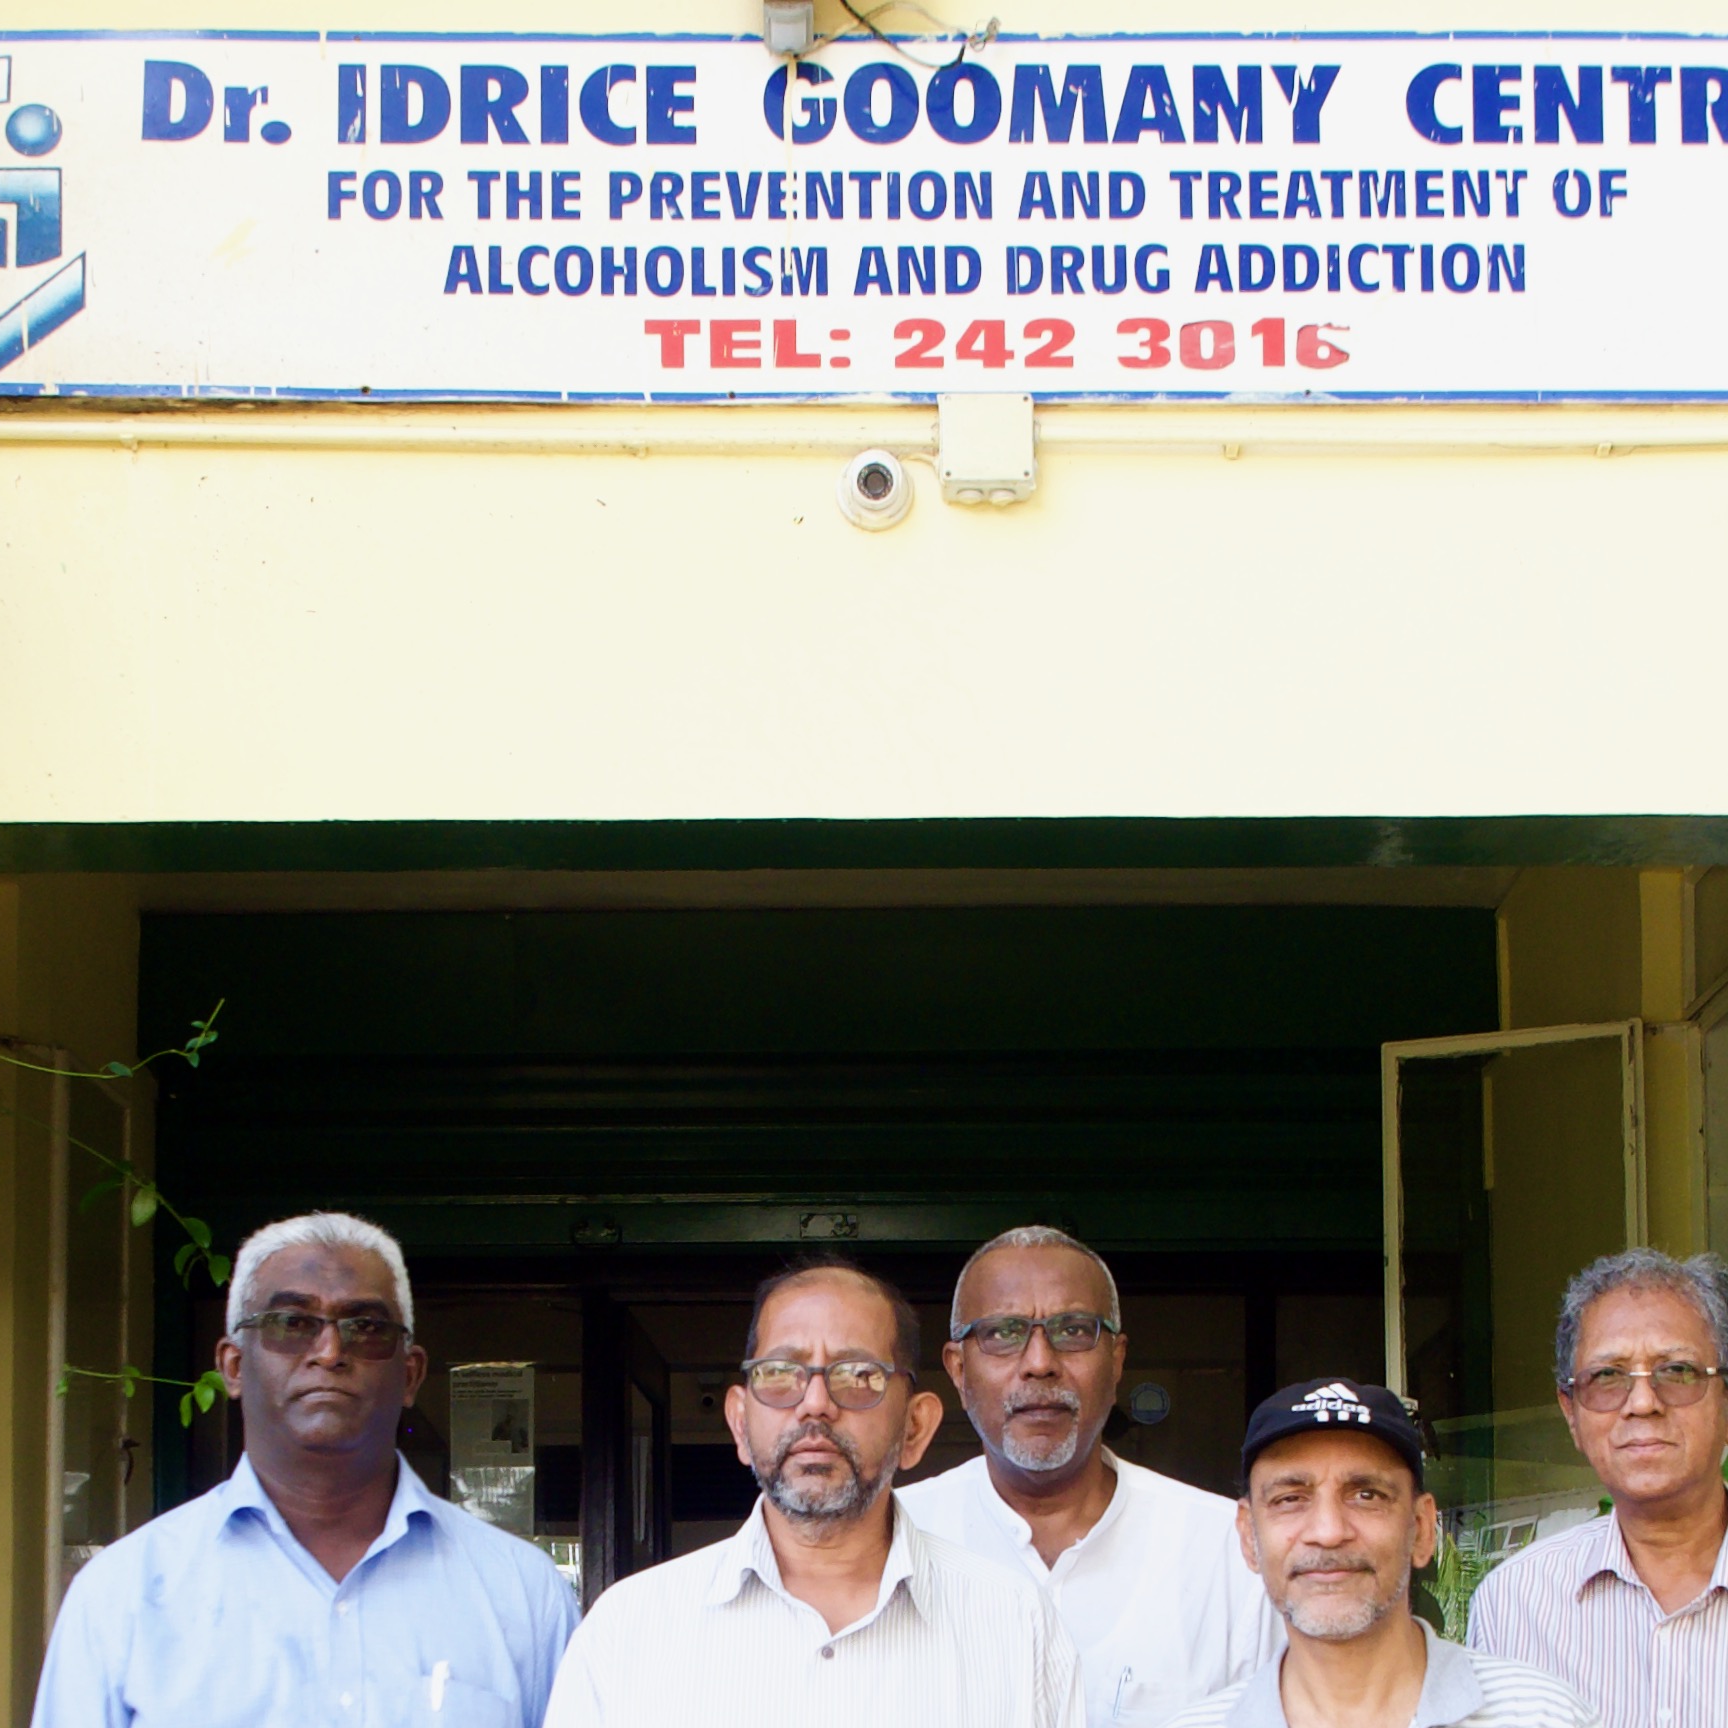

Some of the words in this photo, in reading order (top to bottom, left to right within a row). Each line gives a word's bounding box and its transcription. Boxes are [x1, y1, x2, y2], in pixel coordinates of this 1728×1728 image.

[143, 60, 292, 144] Dr.
[337, 63, 697, 145] IDRICE
[763, 60, 1341, 145] GOOMANY
[327, 169, 443, 220] FOR
[468, 169, 582, 220] THE
[609, 169, 993, 221] PREVENTION
[1018, 170, 1147, 220] AND
[1169, 169, 1529, 219] TREATMENT
[1552, 168, 1629, 219] OF
[443, 244, 829, 297] ALCOHOLISM
[853, 245, 983, 295] AND
[1006, 243, 1171, 295] DRUG
[1194, 242, 1526, 293] ADDICTION
[643, 319, 852, 370] TEL:
[893, 318, 1076, 370] 242
[1117, 317, 1351, 371] 3016
[1291, 1399, 1370, 1416] adidas
